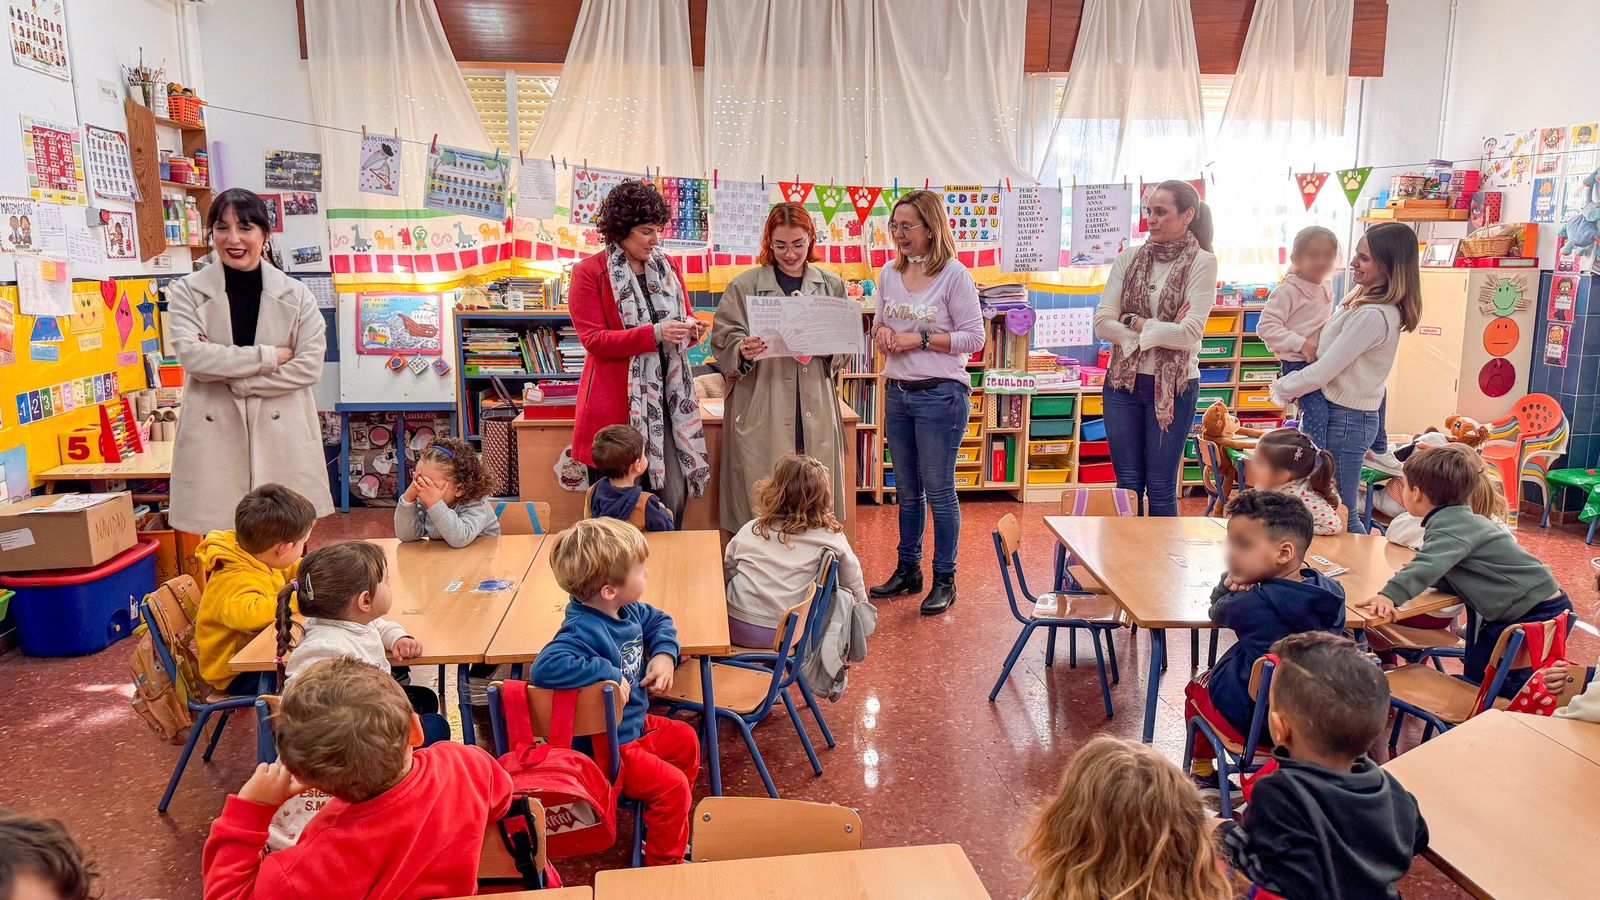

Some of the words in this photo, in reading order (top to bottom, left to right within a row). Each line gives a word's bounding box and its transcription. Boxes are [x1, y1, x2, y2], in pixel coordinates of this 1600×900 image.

[948, 194, 955, 203] C
[959, 194, 967, 203] D
[970, 194, 977, 203] E
[981, 194, 988, 203] F
[991, 194, 999, 203] G
[954, 206, 961, 215] K
[964, 206, 970, 215] L
[974, 206, 985, 215] M
[989, 206, 997, 215] N
[960, 218, 967, 227] R
[970, 218, 977, 227] S
[980, 218, 987, 227] T
[990, 218, 998, 227] U
[959, 230, 966, 239] X
[970, 230, 977, 239] Y
[981, 230, 988, 239] Z
[986, 378, 1034, 388] IGUALDAD
[20, 402, 27, 417] 1
[32, 399, 40, 414] 2
[43, 396, 50, 410] 3
[96, 381, 101, 394] 8
[106, 379, 111, 392] 9
[68, 436, 90, 460] 5
[96, 512, 126, 541] NAVIDAD
